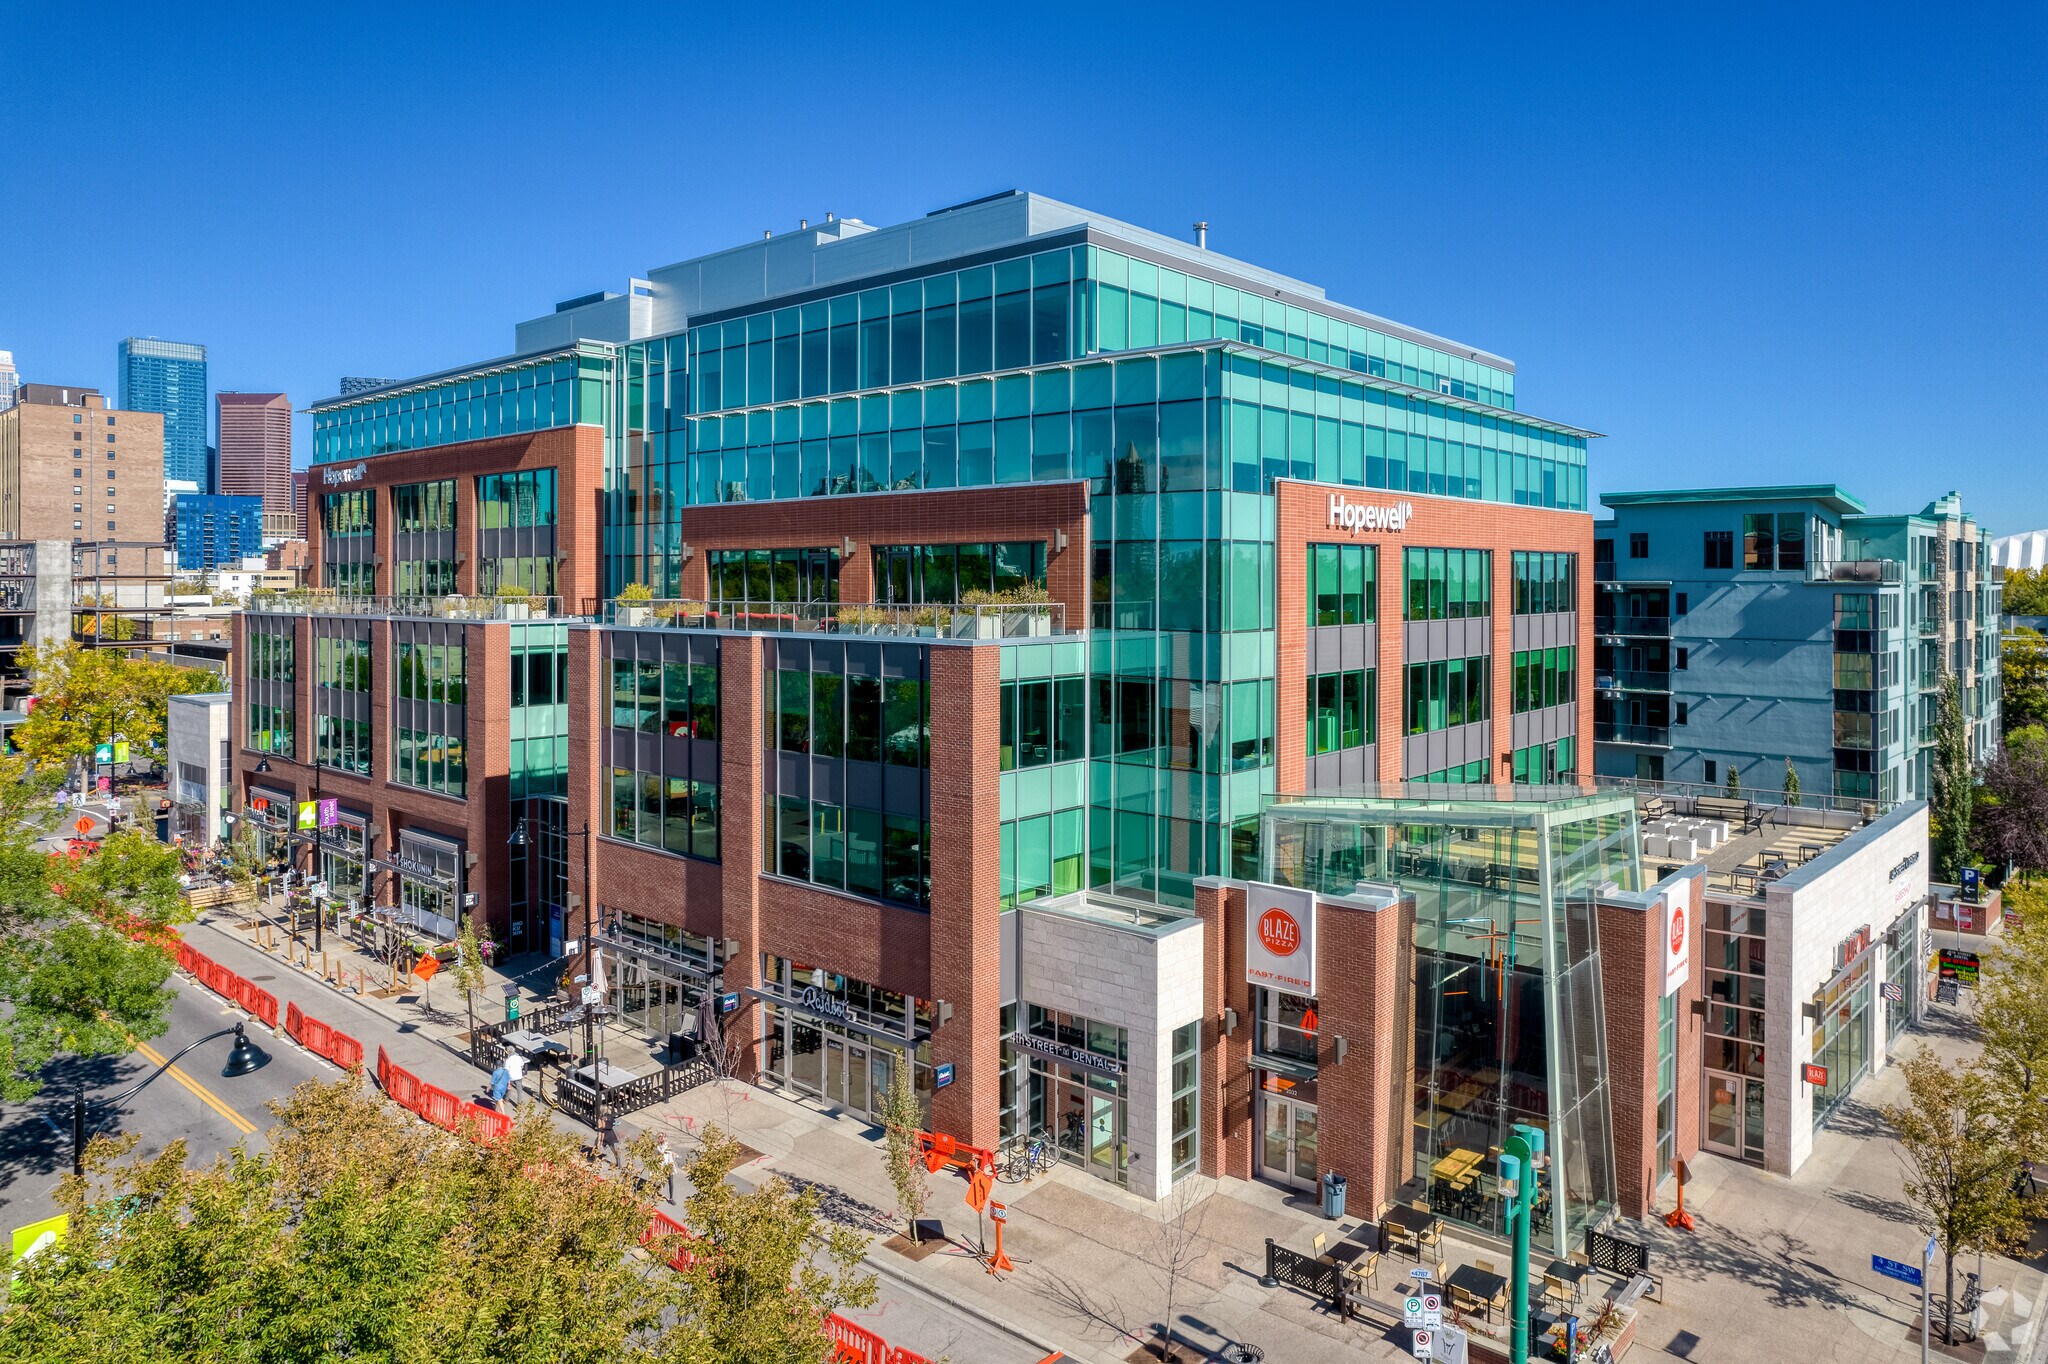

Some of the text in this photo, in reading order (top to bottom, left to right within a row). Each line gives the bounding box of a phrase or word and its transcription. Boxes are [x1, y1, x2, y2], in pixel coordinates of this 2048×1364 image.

[1330, 493, 1406, 535] Hopewell
[96, 747, 112, 762] 4
[299, 806, 316, 825] 4
[400, 858, 433, 877] SHOKUNIN
[1965, 870, 1975, 880] P
[1263, 918, 1295, 942] BLAZE
[1265, 937, 1294, 949] PIZZA
[1249, 968, 1311, 988] FAST-FIRE'D
[1025, 1036, 1062, 1056] STREET
[1072, 1050, 1110, 1071] DENTAL
[1887, 1260, 1899, 1269] ST
[1902, 1265, 1916, 1275] SW
[1410, 1301, 1418, 1310] P
